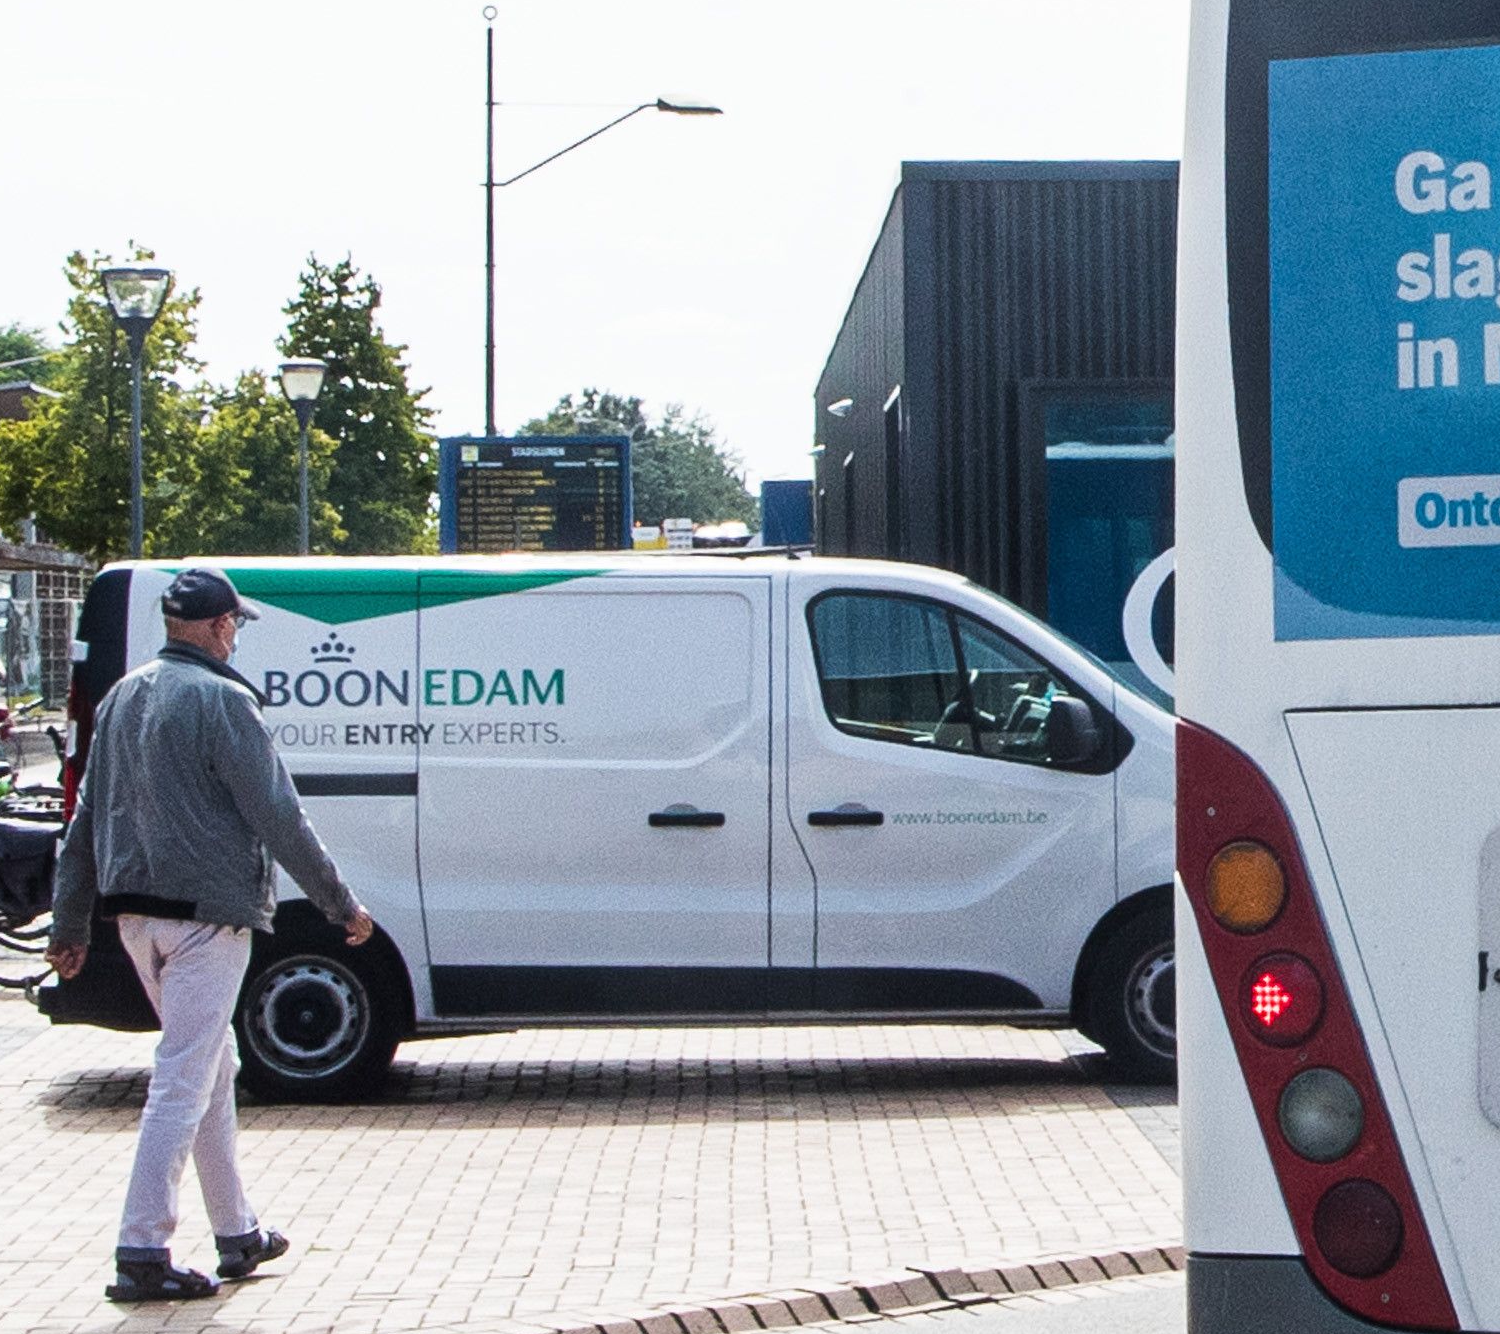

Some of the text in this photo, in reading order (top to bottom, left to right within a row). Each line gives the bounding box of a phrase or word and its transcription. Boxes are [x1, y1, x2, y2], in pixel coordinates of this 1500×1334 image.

[1394, 150, 1491, 214] Ga
[1397, 323, 1459, 389] in
[264, 668, 566, 708] BOON EDAM
[345, 723, 435, 746] ENTRY
[443, 721, 566, 745] EXPERTS.
[892, 809, 1048, 825] www.boonedam.be
